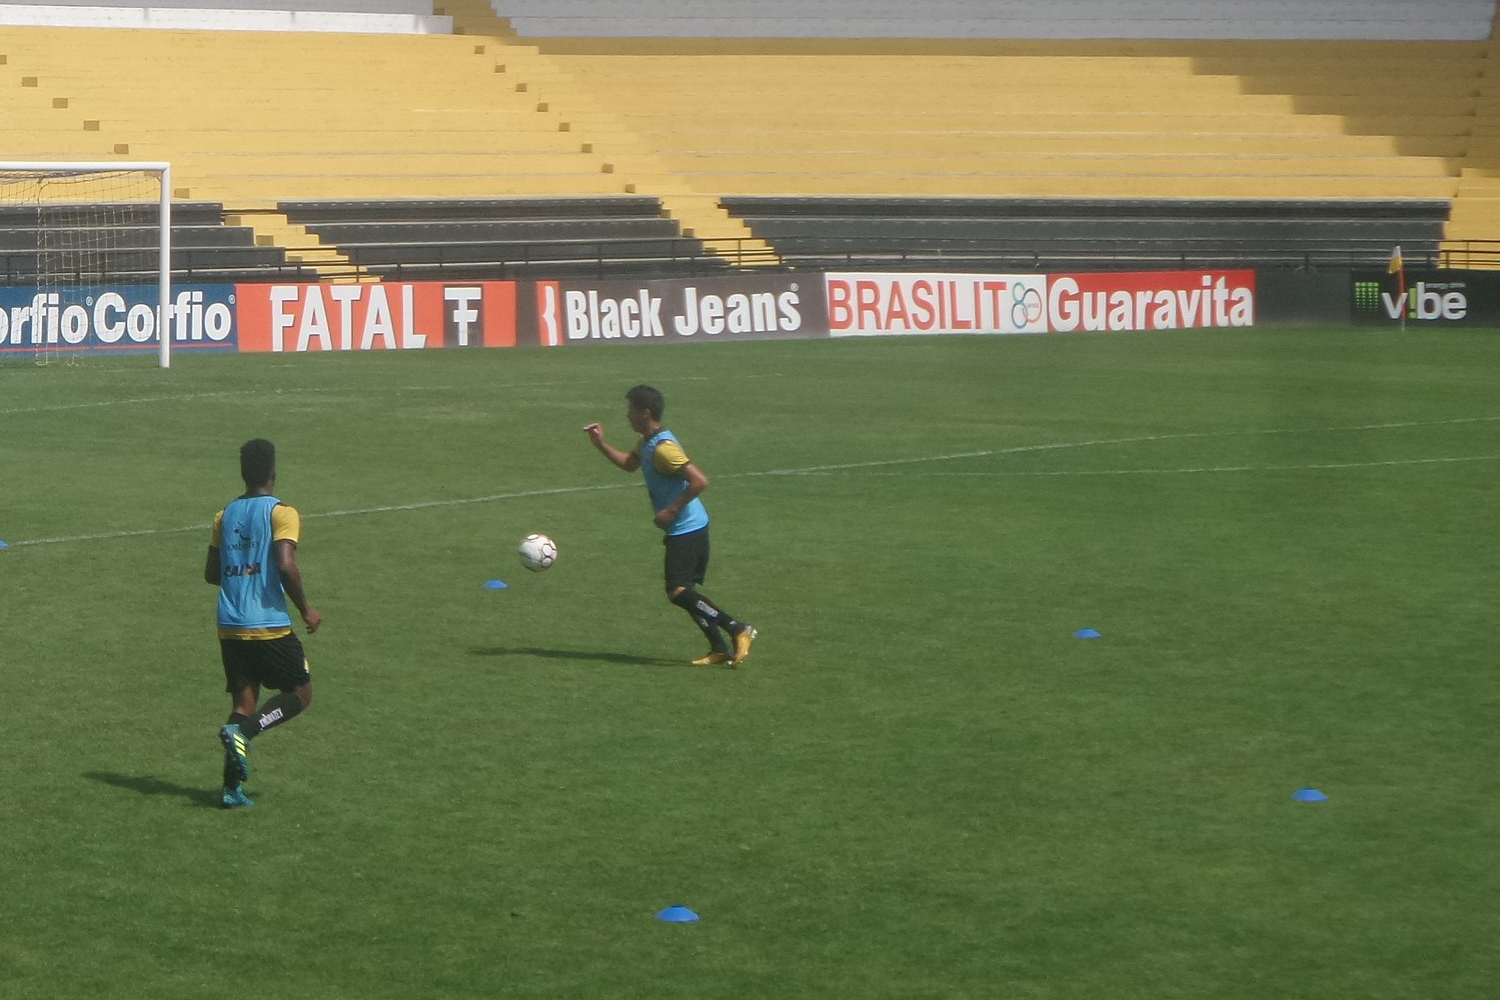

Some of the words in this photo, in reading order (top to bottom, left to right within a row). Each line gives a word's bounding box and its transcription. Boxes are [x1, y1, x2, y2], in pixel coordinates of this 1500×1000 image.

[269, 284, 427, 352] FATAL
[565, 289, 665, 340] Black
[674, 287, 802, 336] Jeans
[828, 280, 1007, 331] BRASILIT
[1048, 274, 1254, 332] Guaravita
